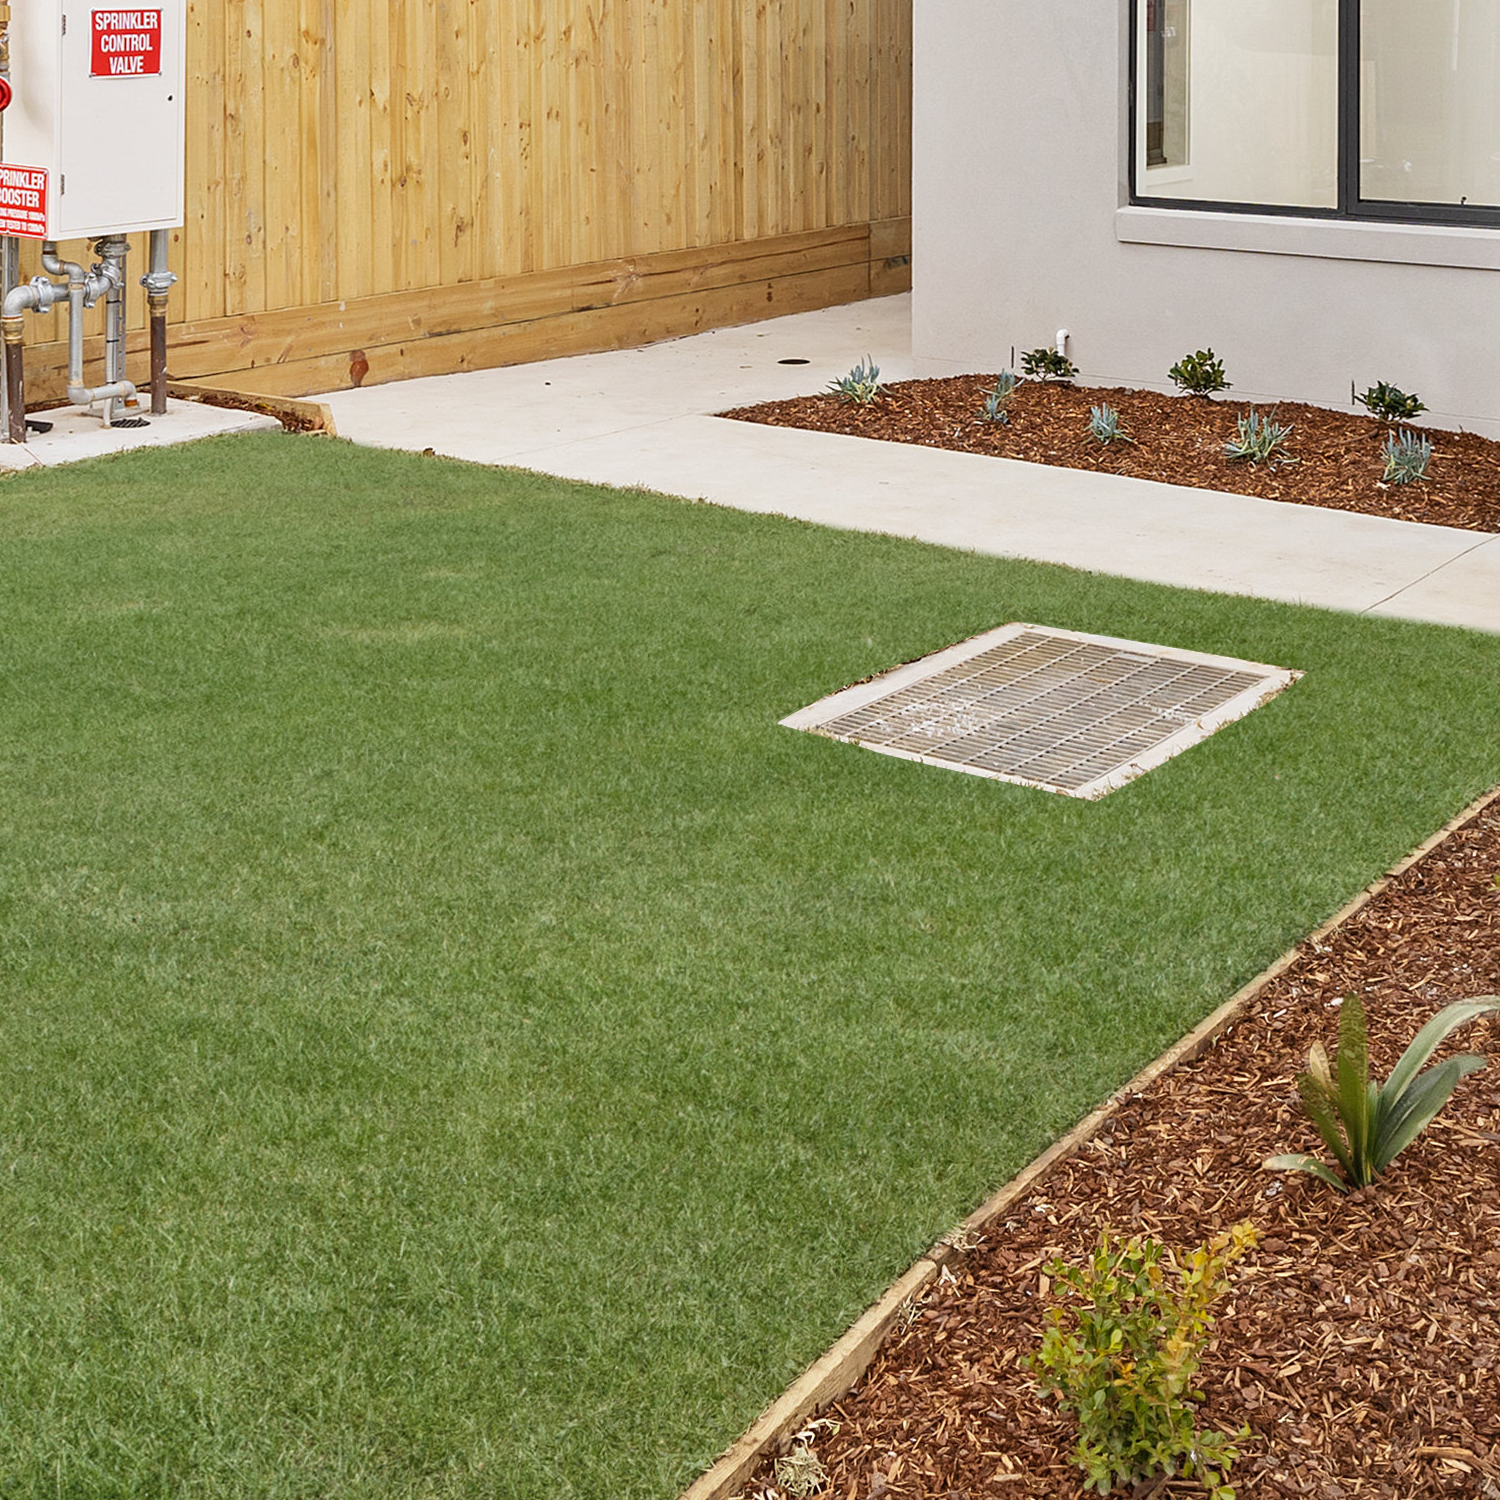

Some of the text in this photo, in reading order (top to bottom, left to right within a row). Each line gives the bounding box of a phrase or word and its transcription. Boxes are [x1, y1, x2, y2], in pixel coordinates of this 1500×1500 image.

[95, 11, 158, 31] SPRINKLER
[100, 33, 153, 53] CONTROL
[109, 55, 144, 74] VALVE
